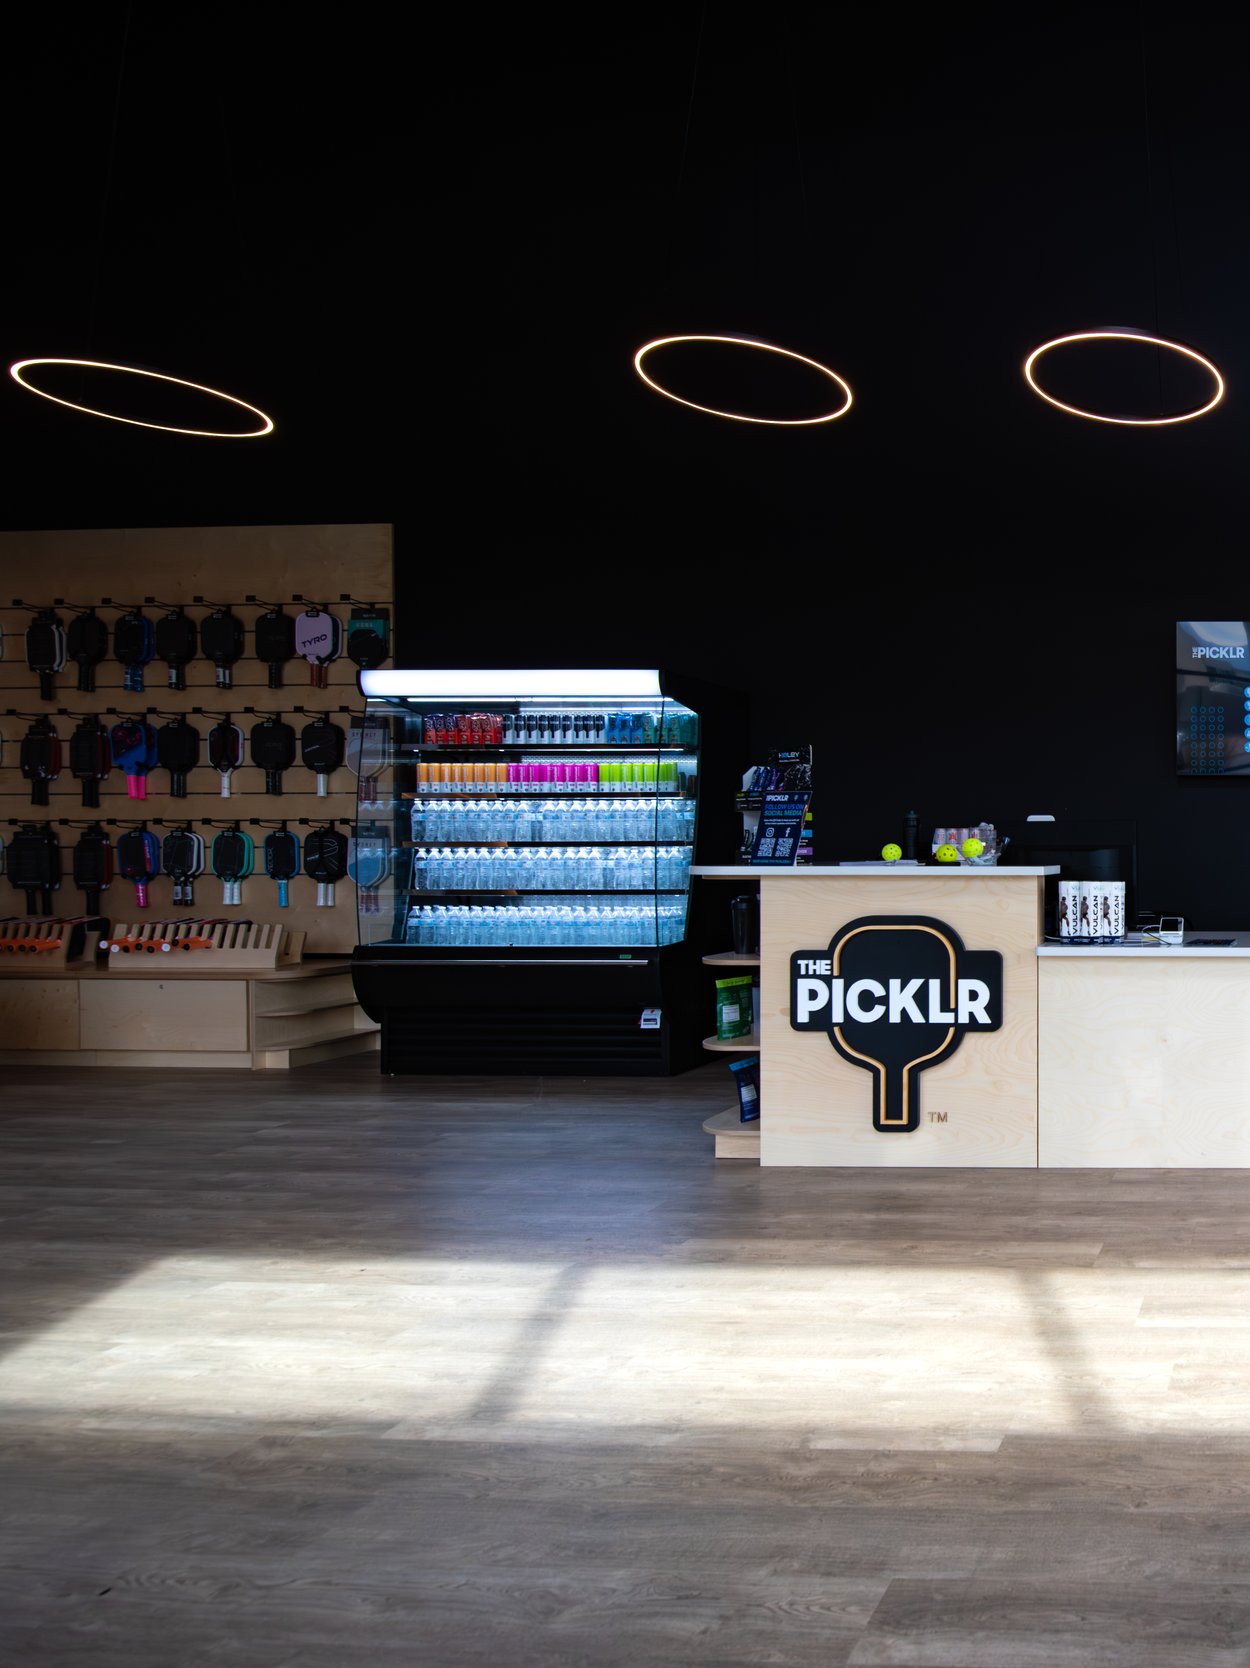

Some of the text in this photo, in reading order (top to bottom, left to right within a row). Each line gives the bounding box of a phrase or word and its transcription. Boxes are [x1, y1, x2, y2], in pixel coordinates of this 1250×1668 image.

[301, 634, 327, 648] TYRO
[1197, 646, 1245, 659] PICKLR
[797, 959, 832, 975] THE
[796, 978, 992, 1024] PICKLR
[928, 1112, 948, 1123] TM
